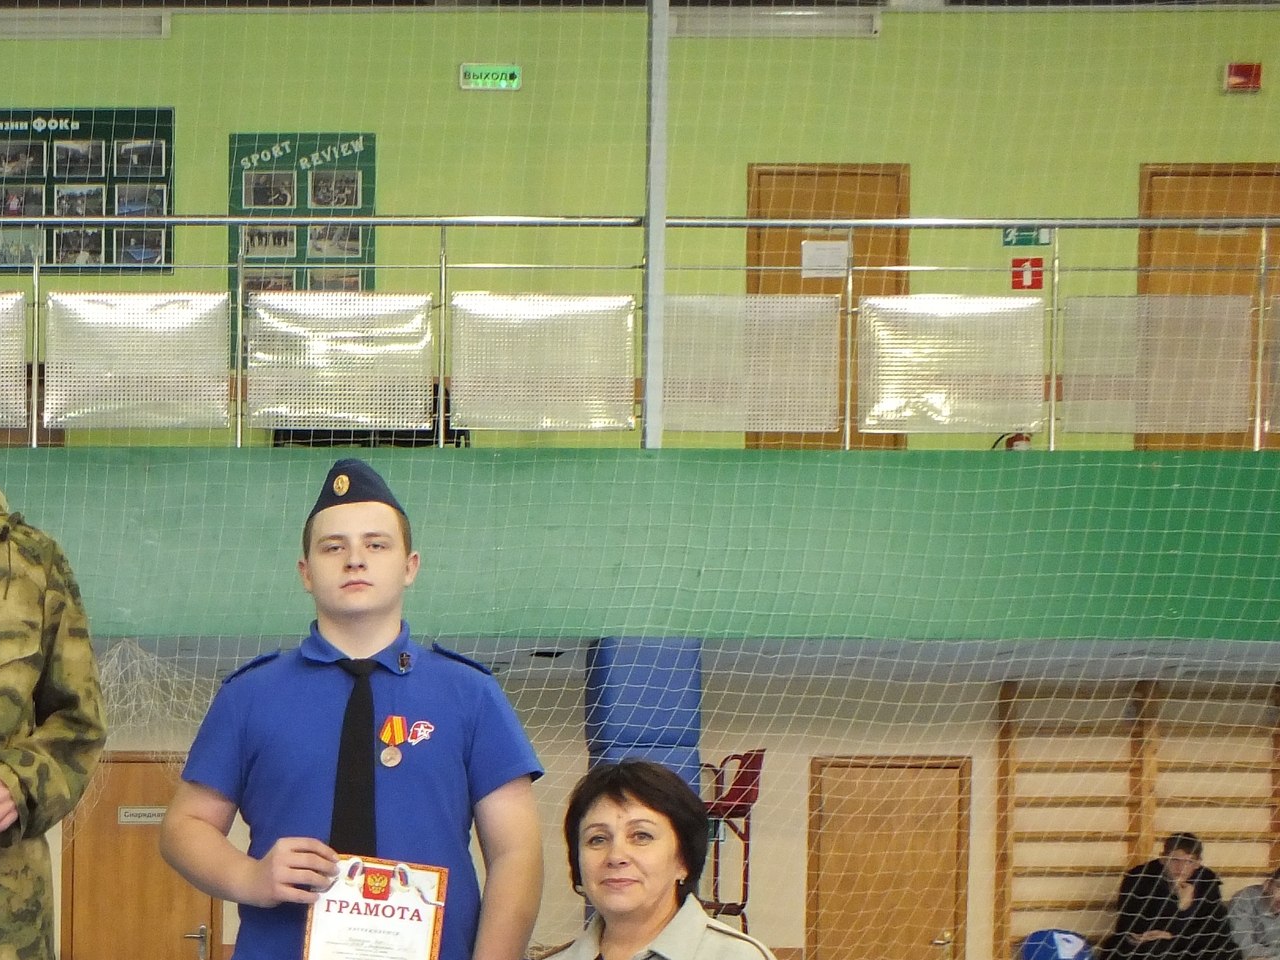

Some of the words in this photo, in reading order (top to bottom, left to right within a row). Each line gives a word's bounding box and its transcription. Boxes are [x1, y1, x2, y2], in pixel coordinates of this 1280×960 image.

[463, 72, 508, 81] ВЫХОД
[240, 140, 291, 170] SPORT
[299, 135, 364, 170] REVIEW
[325, 899, 423, 922] ГРАМОТА
